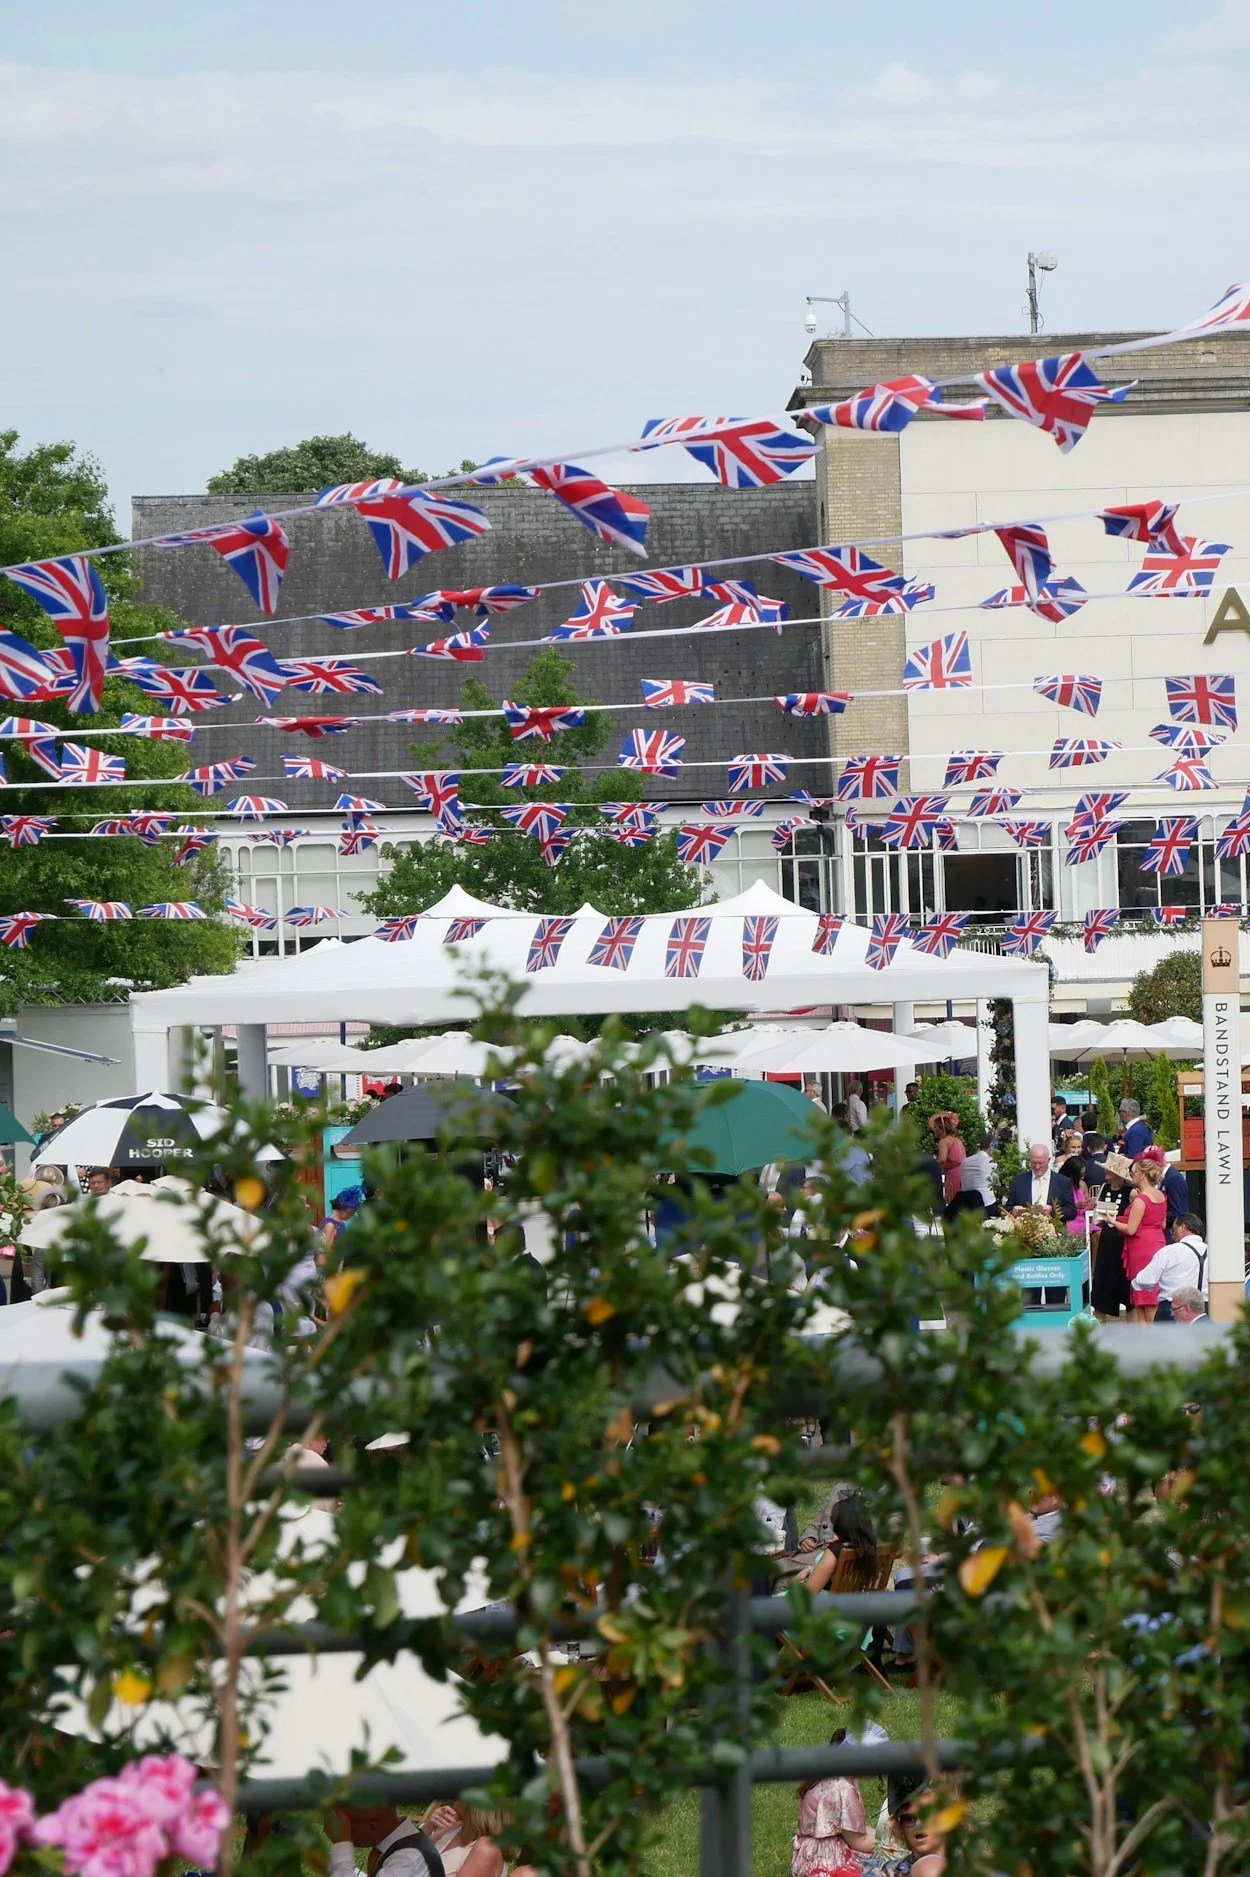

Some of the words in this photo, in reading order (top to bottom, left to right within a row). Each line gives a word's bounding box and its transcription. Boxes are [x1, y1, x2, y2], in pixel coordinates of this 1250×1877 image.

[1215, 1002, 1231, 1120] BANDSTAND
[146, 1138, 175, 1148] SID
[128, 1148, 194, 1159] HOOPER
[1217, 1130, 1231, 1185] LAWN
[1036, 1264, 1061, 1272] Glasses
[1049, 1272, 1065, 1280] Only
